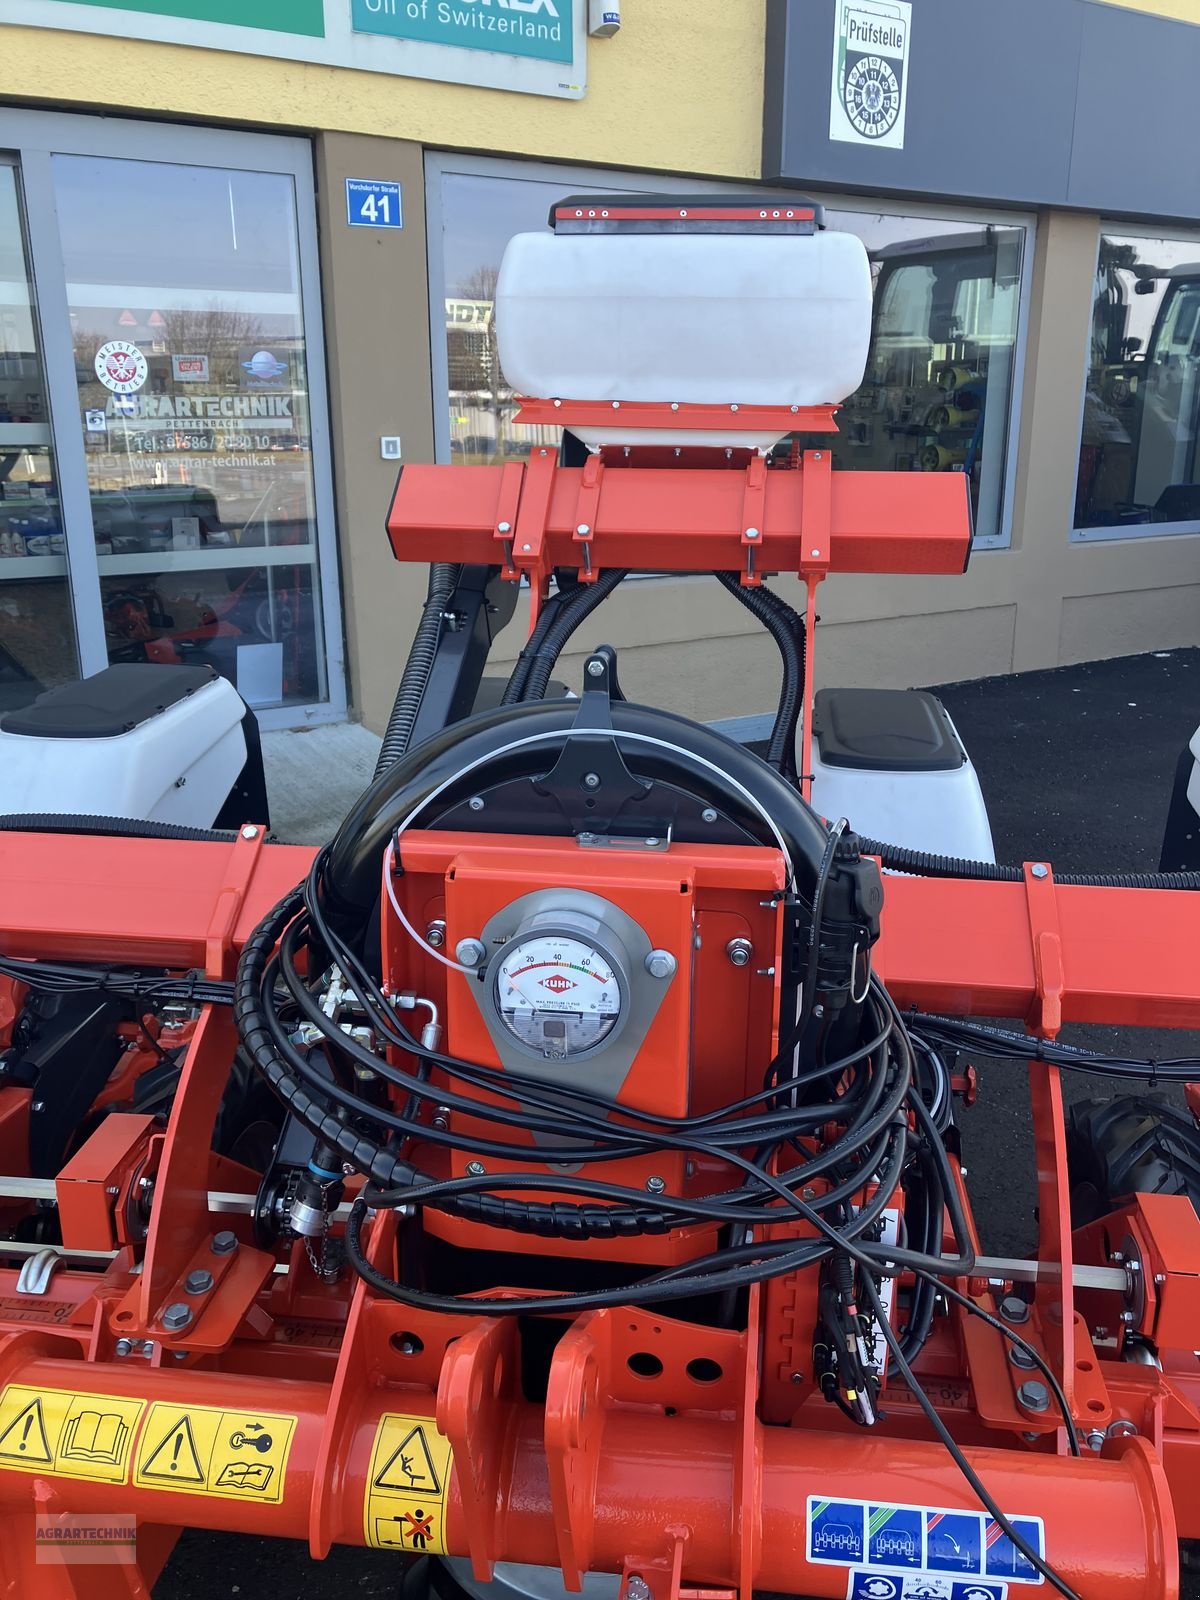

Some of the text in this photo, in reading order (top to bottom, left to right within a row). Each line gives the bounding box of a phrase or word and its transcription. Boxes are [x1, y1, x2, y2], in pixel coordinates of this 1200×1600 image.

[406, 0, 428, 19] of
[438, 2, 561, 41] Switzerland
[849, 18, 903, 49] Prüfstelle
[870, 70, 877, 79] 11
[881, 81, 889, 90] 12
[861, 111, 869, 119] 15
[360, 194, 390, 223] 41
[98, 342, 143, 362] MEISTER
[99, 371, 145, 392] BETRIEB
[105, 395, 292, 418] AGRARTECHNIK
[165, 420, 240, 429] PETTENBACH
[134, 435, 164, 450] Tel.:
[254, 434, 270, 448] 10
[502, 967, 509, 975] 0
[525, 955, 536, 963] 20
[552, 953, 562, 961] 40
[581, 958, 591, 966] 60
[541, 977, 574, 989] KUHN
